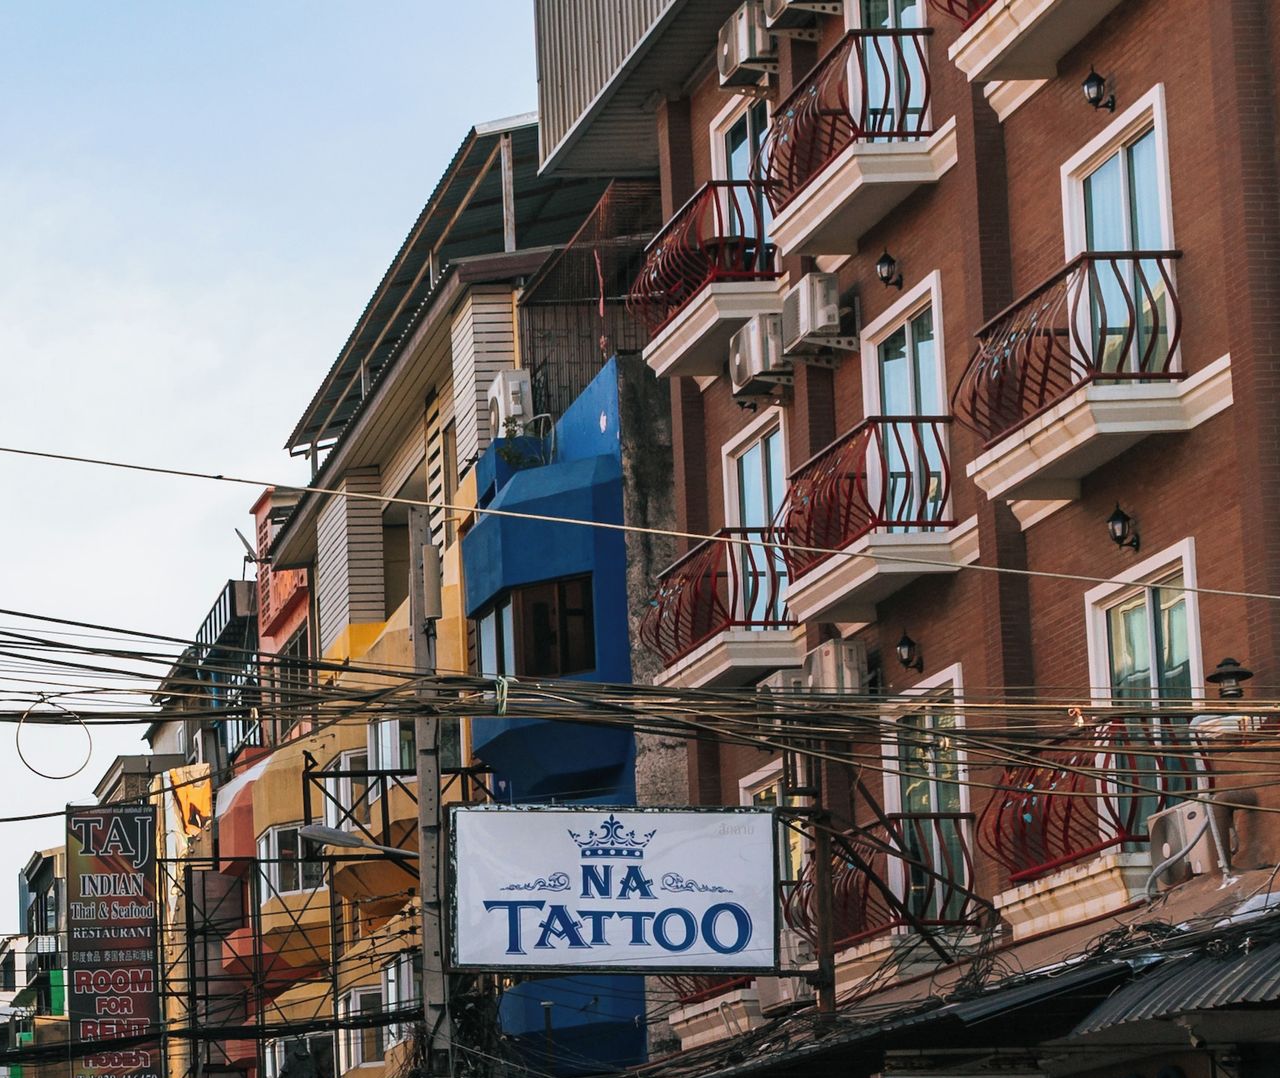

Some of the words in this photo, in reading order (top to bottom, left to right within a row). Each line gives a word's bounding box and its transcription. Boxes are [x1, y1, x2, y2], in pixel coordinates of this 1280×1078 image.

[71, 816, 152, 869] TAJ
[80, 873, 145, 897] INDIAN
[579, 863, 659, 900] NA
[71, 902, 96, 919] Thai
[98, 902, 109, 919] &
[111, 901, 155, 919] Seafood
[73, 926, 152, 939] RESTAURANT
[482, 899, 753, 955] TATTOO
[74, 969, 154, 994] ROOM
[96, 996, 133, 1014] FOR
[80, 1018, 150, 1042] RENT
